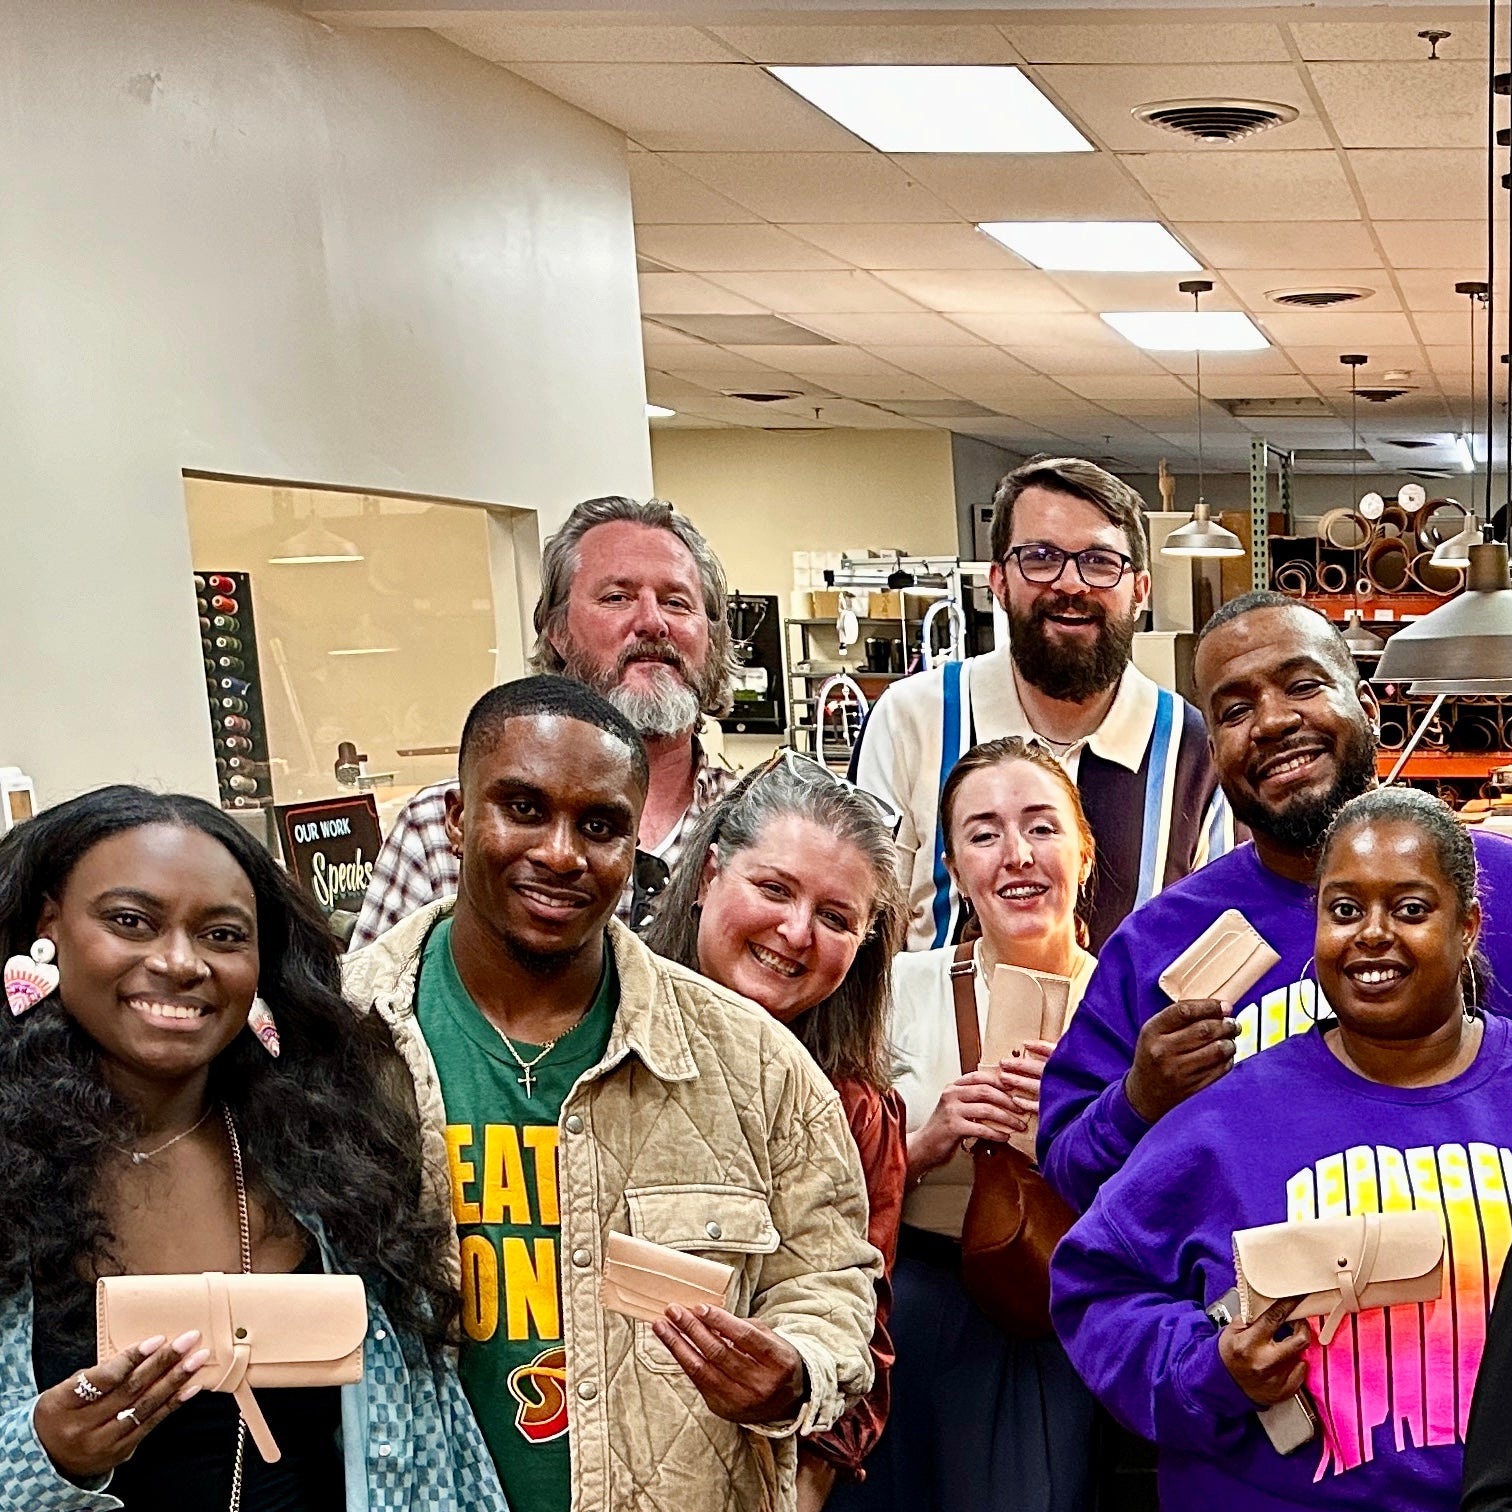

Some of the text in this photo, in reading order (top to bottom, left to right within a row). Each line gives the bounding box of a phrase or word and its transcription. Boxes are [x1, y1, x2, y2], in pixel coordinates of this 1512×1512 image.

[294, 817, 351, 844] OUR WORK
[312, 847, 373, 908] Speaks
[460, 1234, 561, 1342] ON
